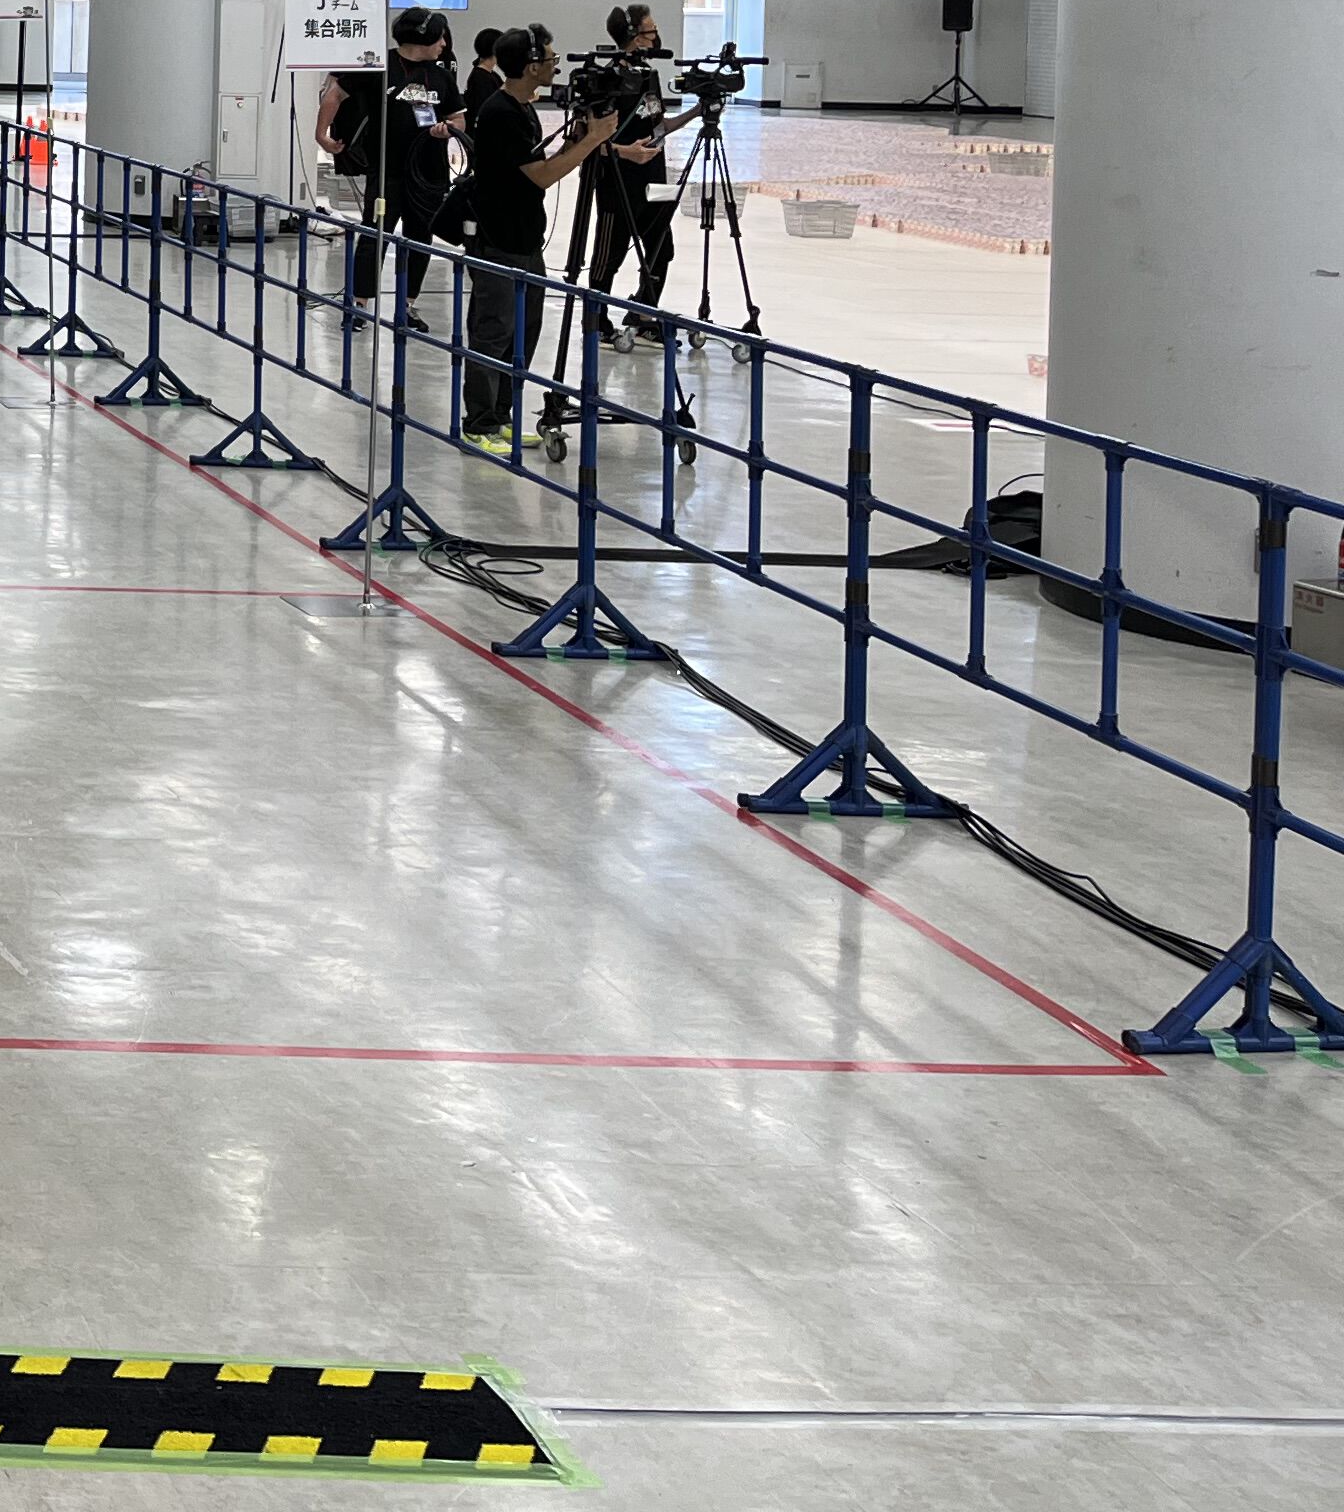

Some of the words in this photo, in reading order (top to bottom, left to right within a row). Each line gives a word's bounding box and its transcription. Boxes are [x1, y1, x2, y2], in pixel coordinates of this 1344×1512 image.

[331, 0, 359, 11] チーム
[304, 19, 368, 39] 集合場所
